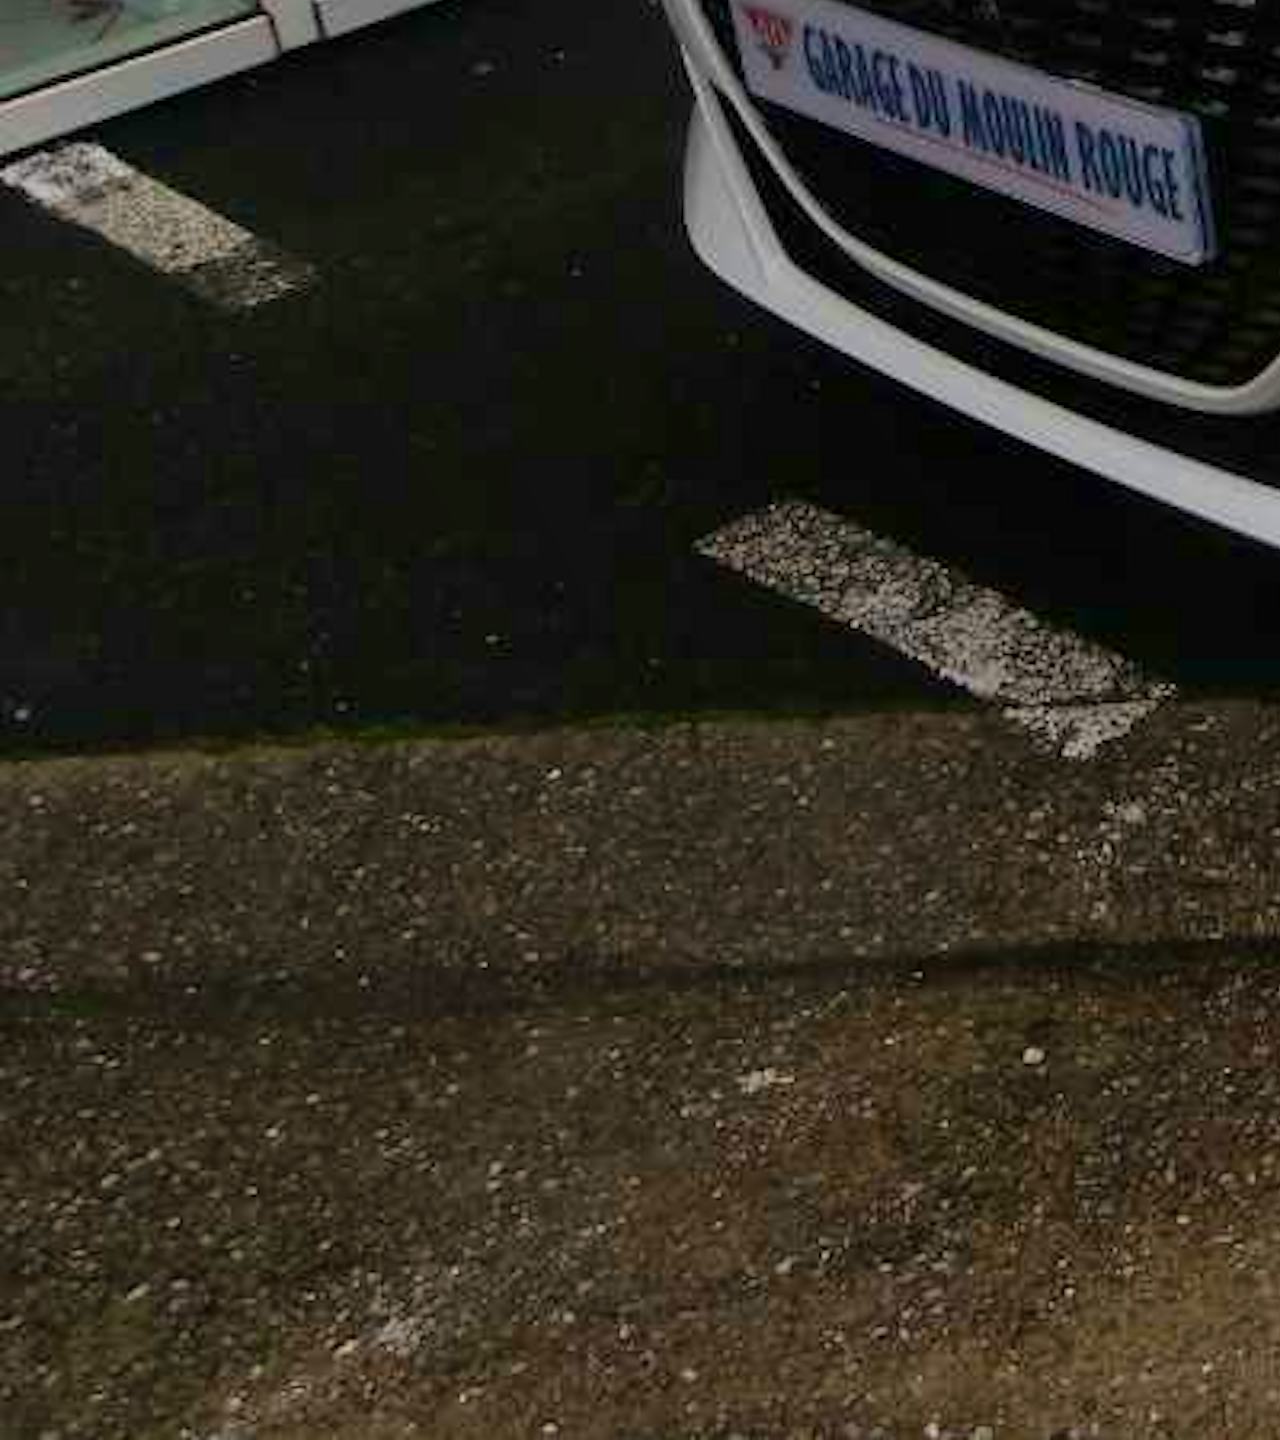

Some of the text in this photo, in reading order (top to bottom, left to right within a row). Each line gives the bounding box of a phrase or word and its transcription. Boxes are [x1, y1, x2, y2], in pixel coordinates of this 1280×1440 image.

[802, 26, 910, 121] GARAGE
[908, 63, 951, 136] DU
[957, 79, 1070, 181] MOULIN
[1076, 121, 1184, 221] ROUGE
